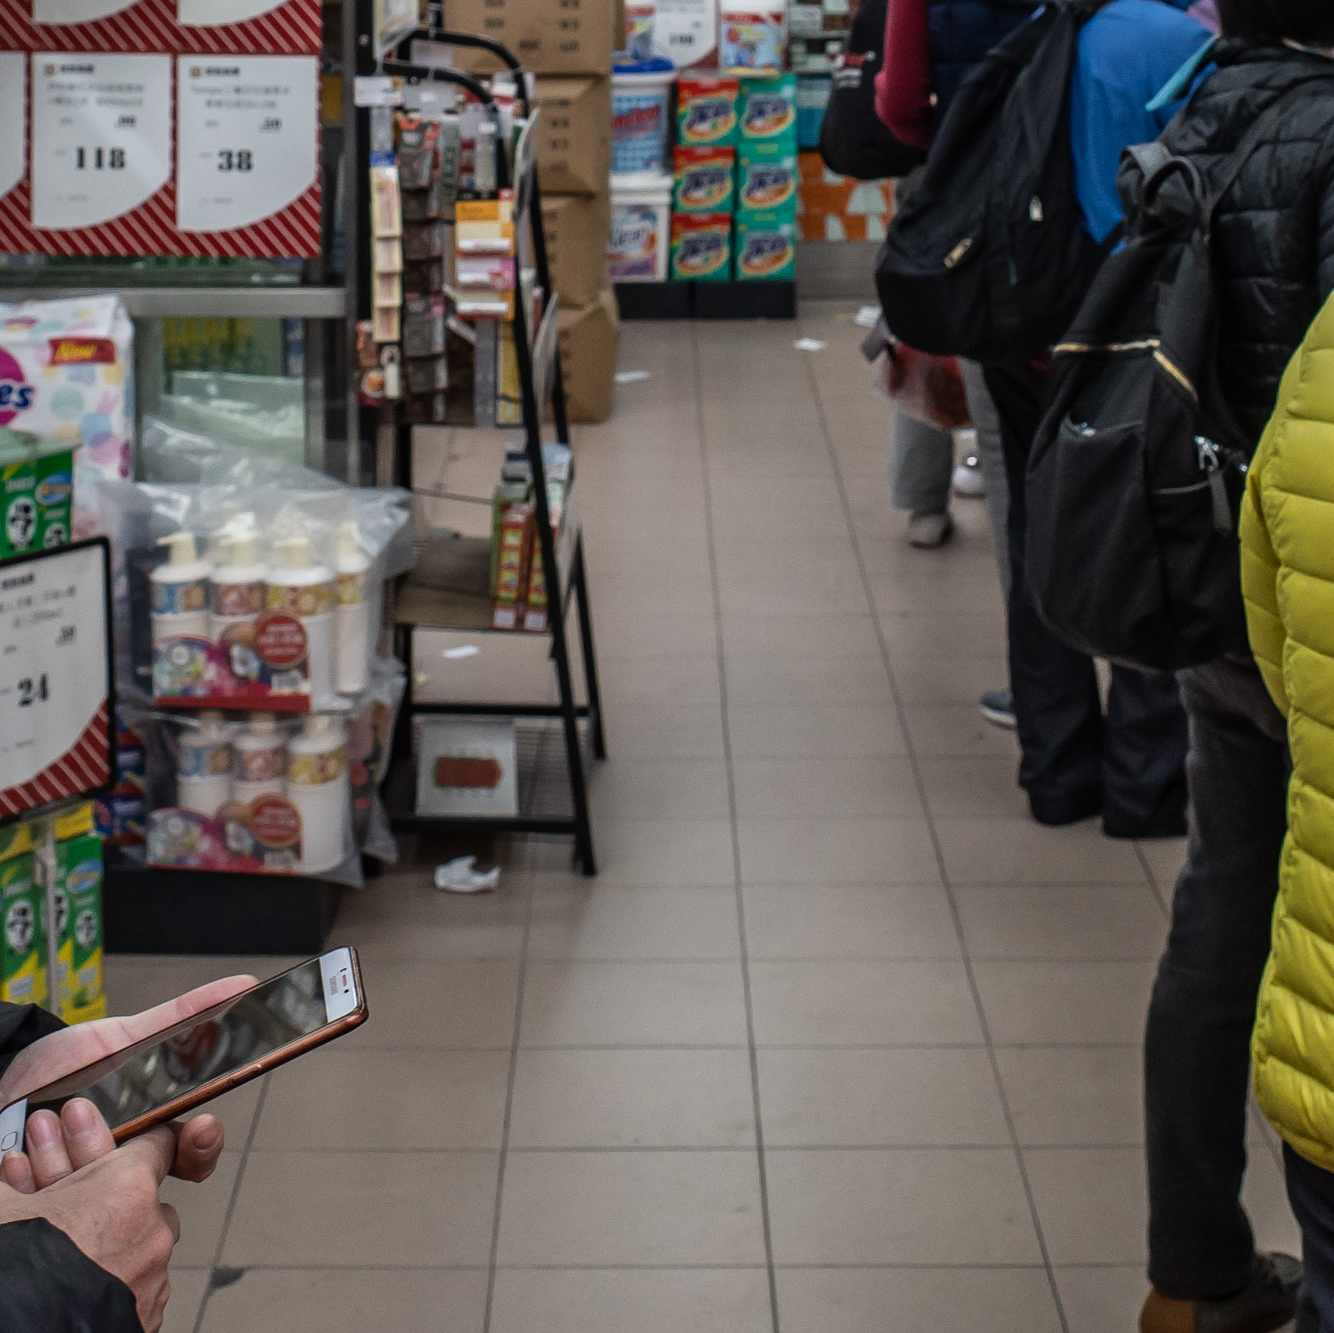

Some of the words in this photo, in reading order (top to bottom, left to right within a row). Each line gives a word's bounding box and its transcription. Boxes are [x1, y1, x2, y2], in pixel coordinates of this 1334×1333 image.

[75, 147, 126, 170] 118
[217, 149, 253, 172] 38
[17, 673, 51, 707] 24
